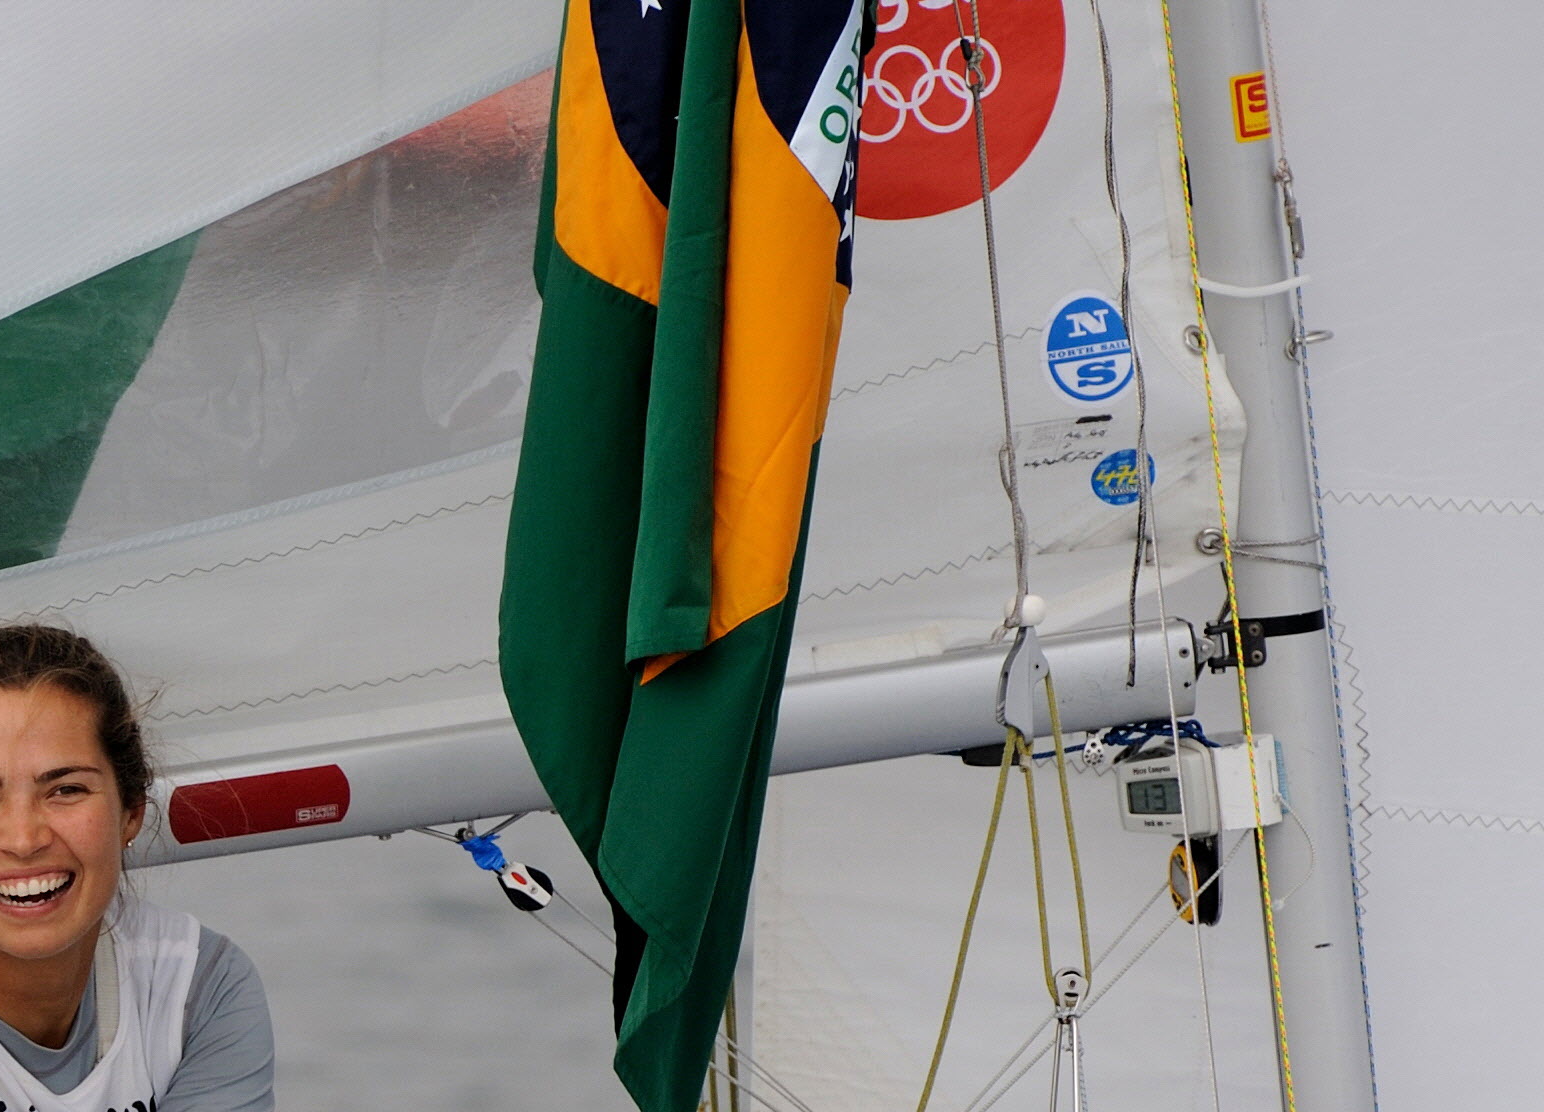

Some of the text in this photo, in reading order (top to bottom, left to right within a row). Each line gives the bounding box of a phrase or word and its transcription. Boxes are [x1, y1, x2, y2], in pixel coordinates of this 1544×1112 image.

[1065, 308, 1109, 338] N
[1048, 340, 1128, 359] NORTH SAIL
[1077, 359, 1117, 388] S
